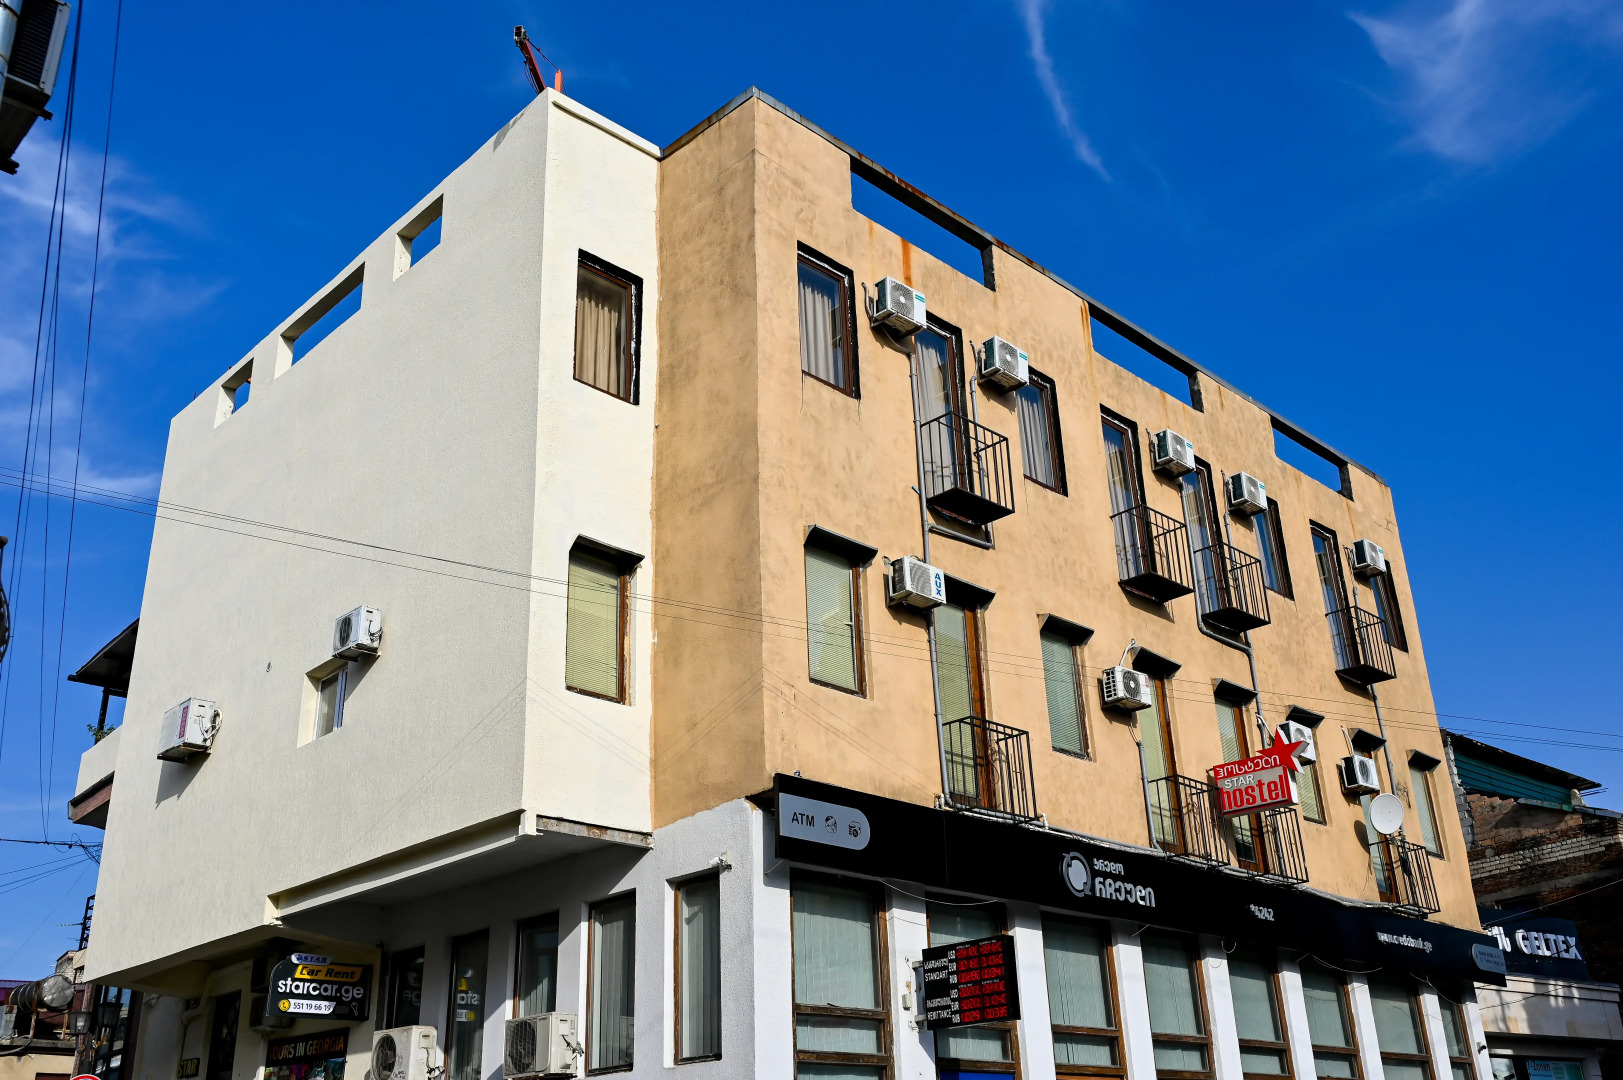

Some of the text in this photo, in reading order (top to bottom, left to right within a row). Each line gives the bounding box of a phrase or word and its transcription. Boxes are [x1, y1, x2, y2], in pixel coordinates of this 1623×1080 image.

[934, 573, 942, 596] AUX
[1224, 774, 1255, 789] STAR
[1220, 774, 1287, 811] hostel
[791, 811, 815, 827] ATM
[1515, 928, 1583, 960] GELTEX
[299, 966, 357, 980] Car Rent
[948, 962, 957, 972] EUR
[924, 969, 949, 982] STANDART
[949, 974, 958, 984] RUB
[277, 977, 364, 1002] starcar.ge
[293, 1002, 304, 1010] 551
[305, 1002, 313, 1010] 19
[324, 1004, 332, 1012] 19
[951, 1001, 960, 1012] EUR
[927, 1008, 952, 1021] REMITTANCE
[952, 1013, 961, 1024] RUB
[269, 1035, 344, 1060] TOURS IN GEORGIA
